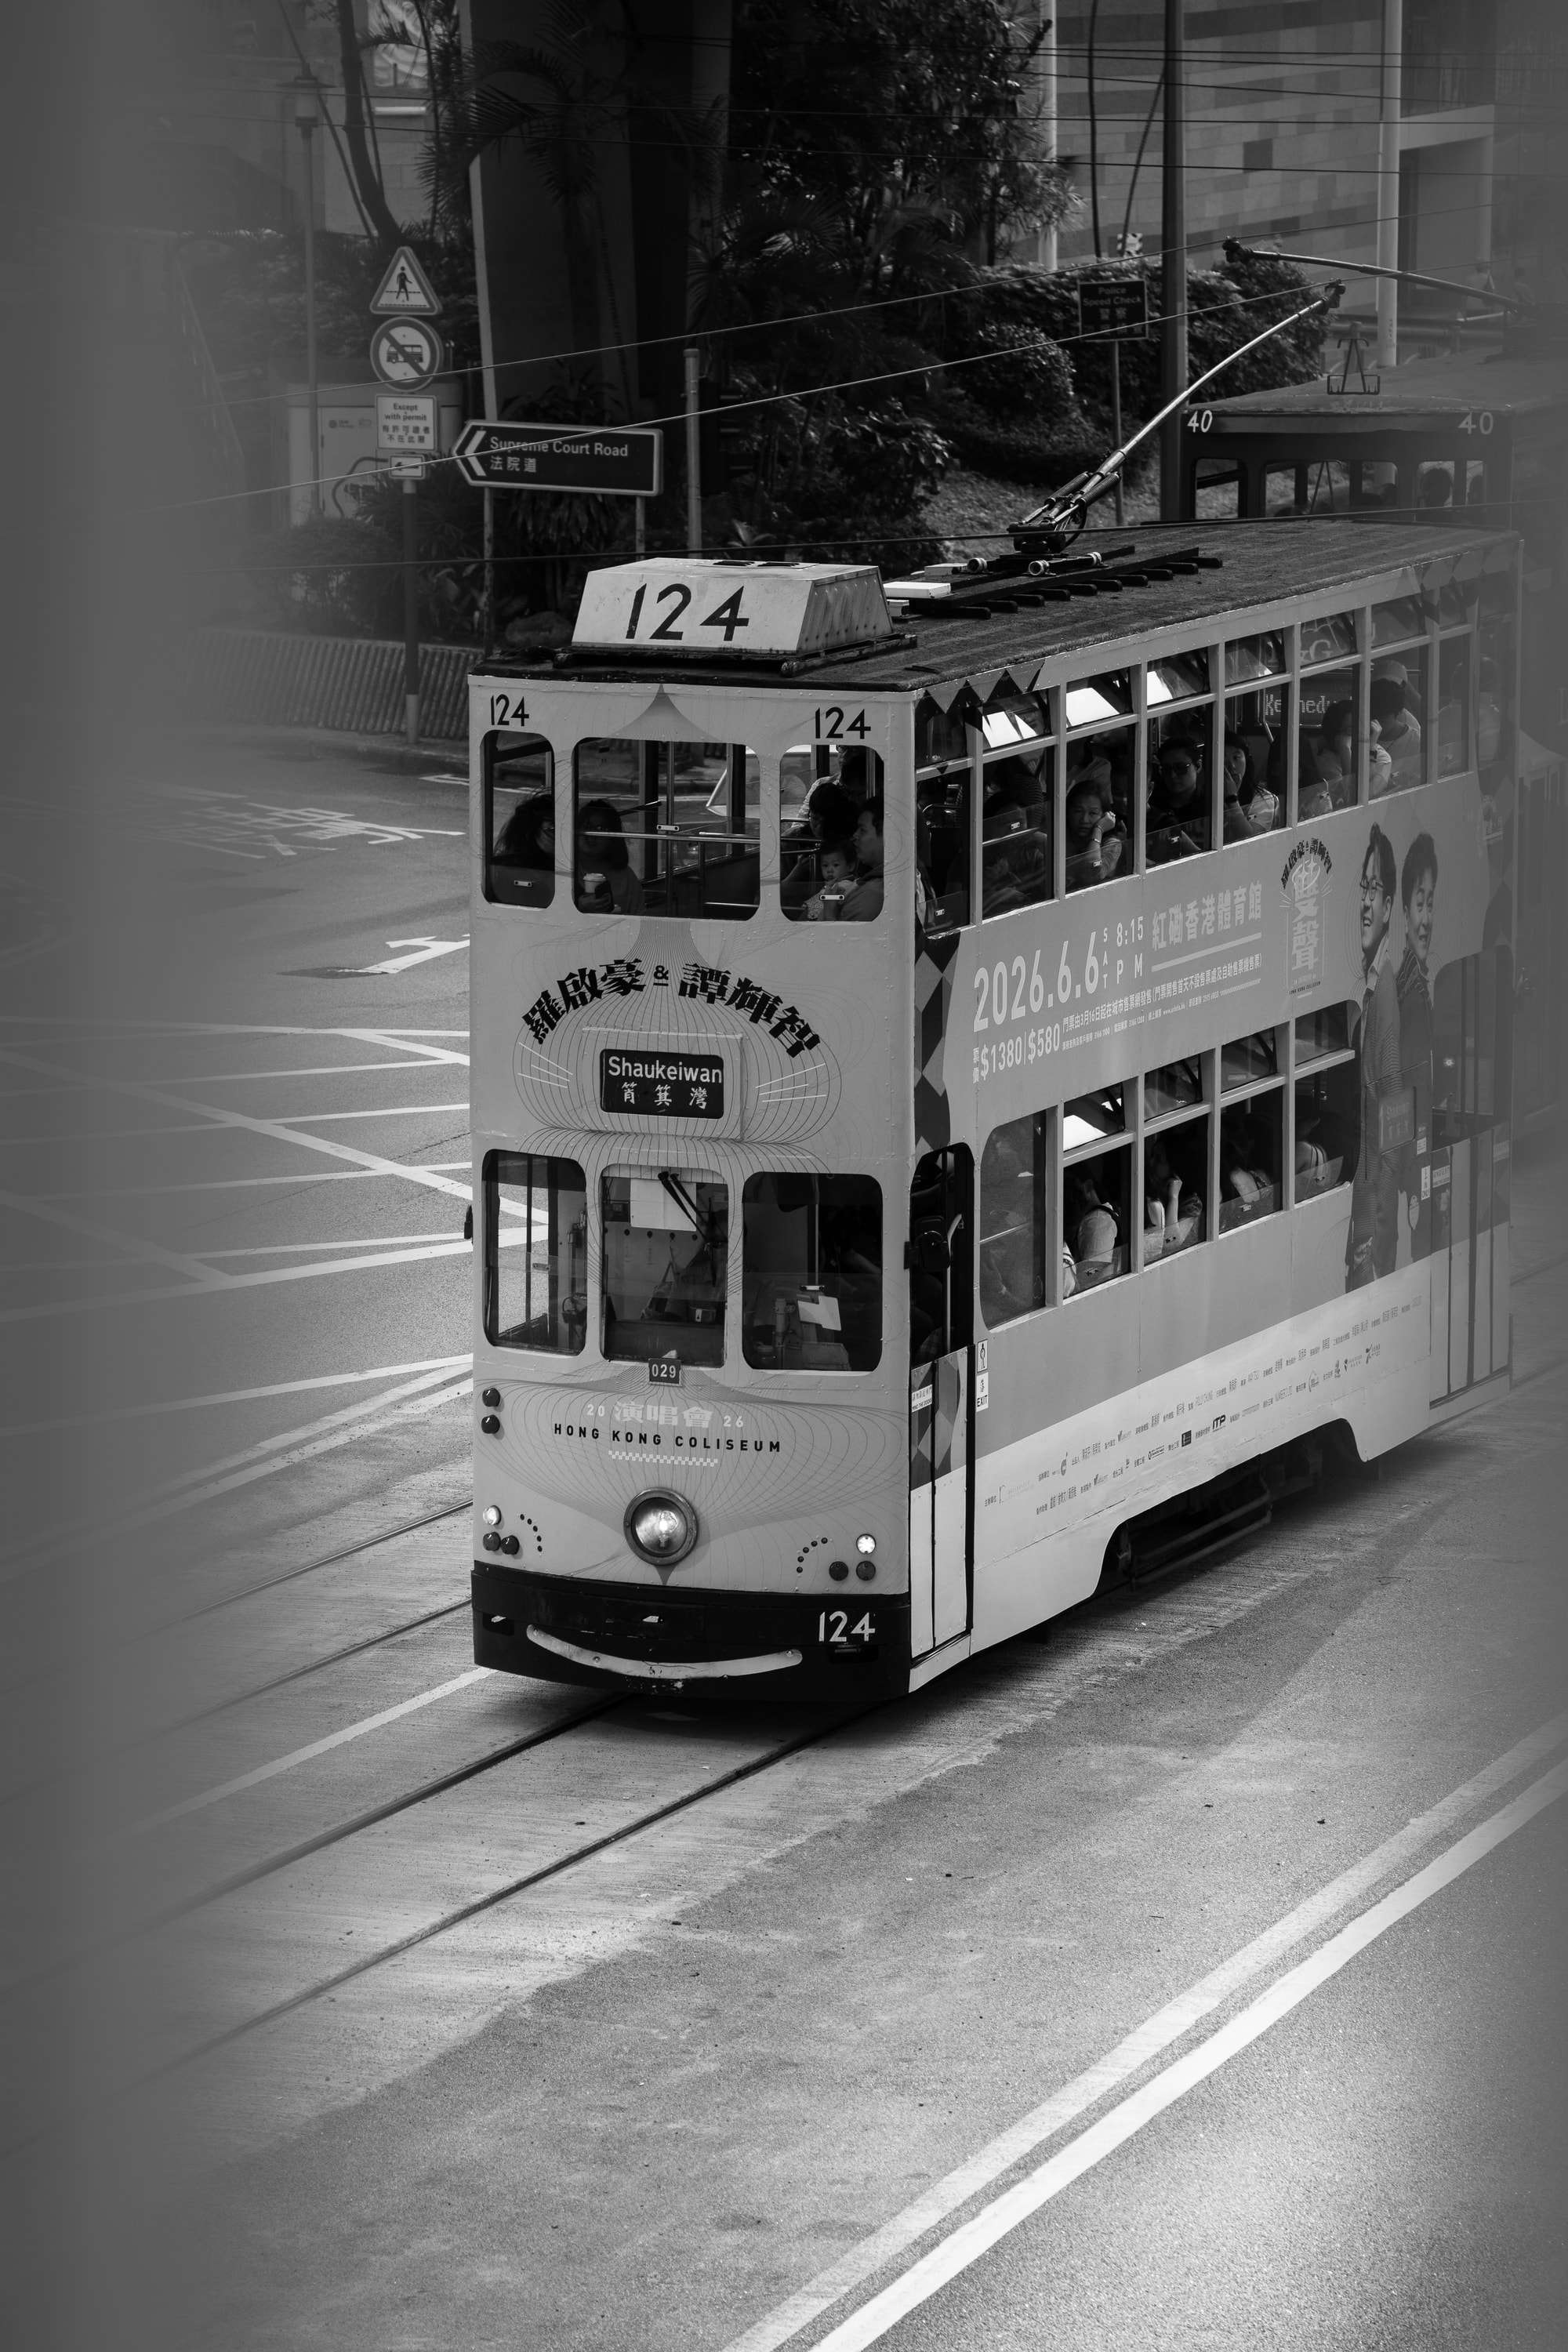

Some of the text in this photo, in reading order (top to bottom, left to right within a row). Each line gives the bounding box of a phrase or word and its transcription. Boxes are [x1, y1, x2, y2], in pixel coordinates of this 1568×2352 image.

[1083, 296, 1141, 307] Speed Check
[394, 402, 419, 412] Except
[1188, 410, 1213, 433] 40
[1458, 412, 1493, 435] 40
[490, 436, 628, 456] Supreme Court Road
[490, 456, 537, 473] 法院道
[626, 583, 750, 641] 124
[490, 694, 530, 727] 124
[815, 706, 871, 740] 124
[1151, 881, 1262, 950] 紅磡香港體育館
[1116, 916, 1143, 947] 8:15
[974, 931, 1099, 1033] 2026.6.6
[521, 958, 821, 1058] 羅啟豪 & 譚輝智
[972, 1047, 979, 1083] 票價
[980, 1036, 1022, 1080] $1380
[1028, 1022, 1060, 1064] $580
[608, 1056, 722, 1083] Shaukeiwan
[621, 1082, 708, 1109] 筲箕灣
[652, 1363, 677, 1380] 029
[586, 1401, 745, 1429] 20 演唱會 26
[977, 1395, 988, 1407] EXIT
[554, 1423, 782, 1453] HONG KONG COLISEUM
[818, 1611, 876, 1642] 124
